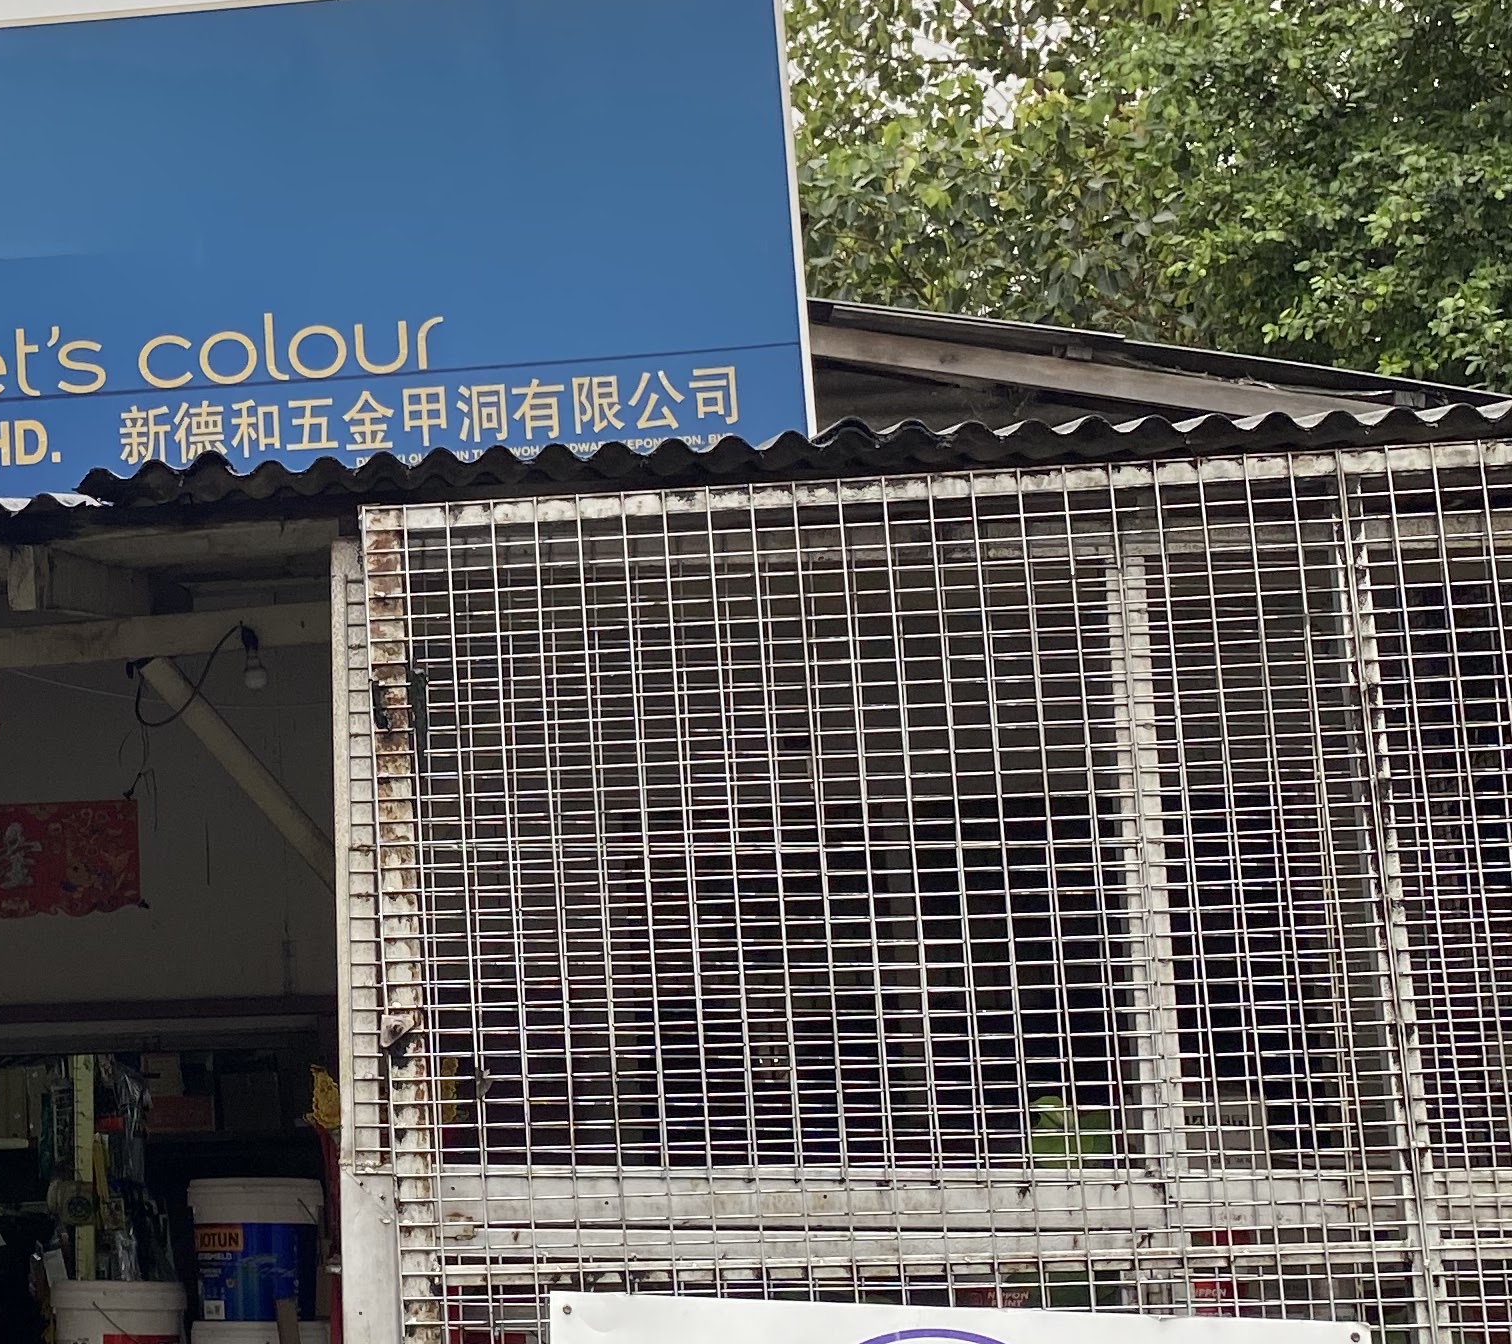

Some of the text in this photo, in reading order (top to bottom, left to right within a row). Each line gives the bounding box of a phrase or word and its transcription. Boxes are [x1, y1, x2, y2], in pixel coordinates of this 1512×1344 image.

[138, 312, 445, 389] colour
[119, 365, 740, 464] 新德和五金甲洞有限公司
